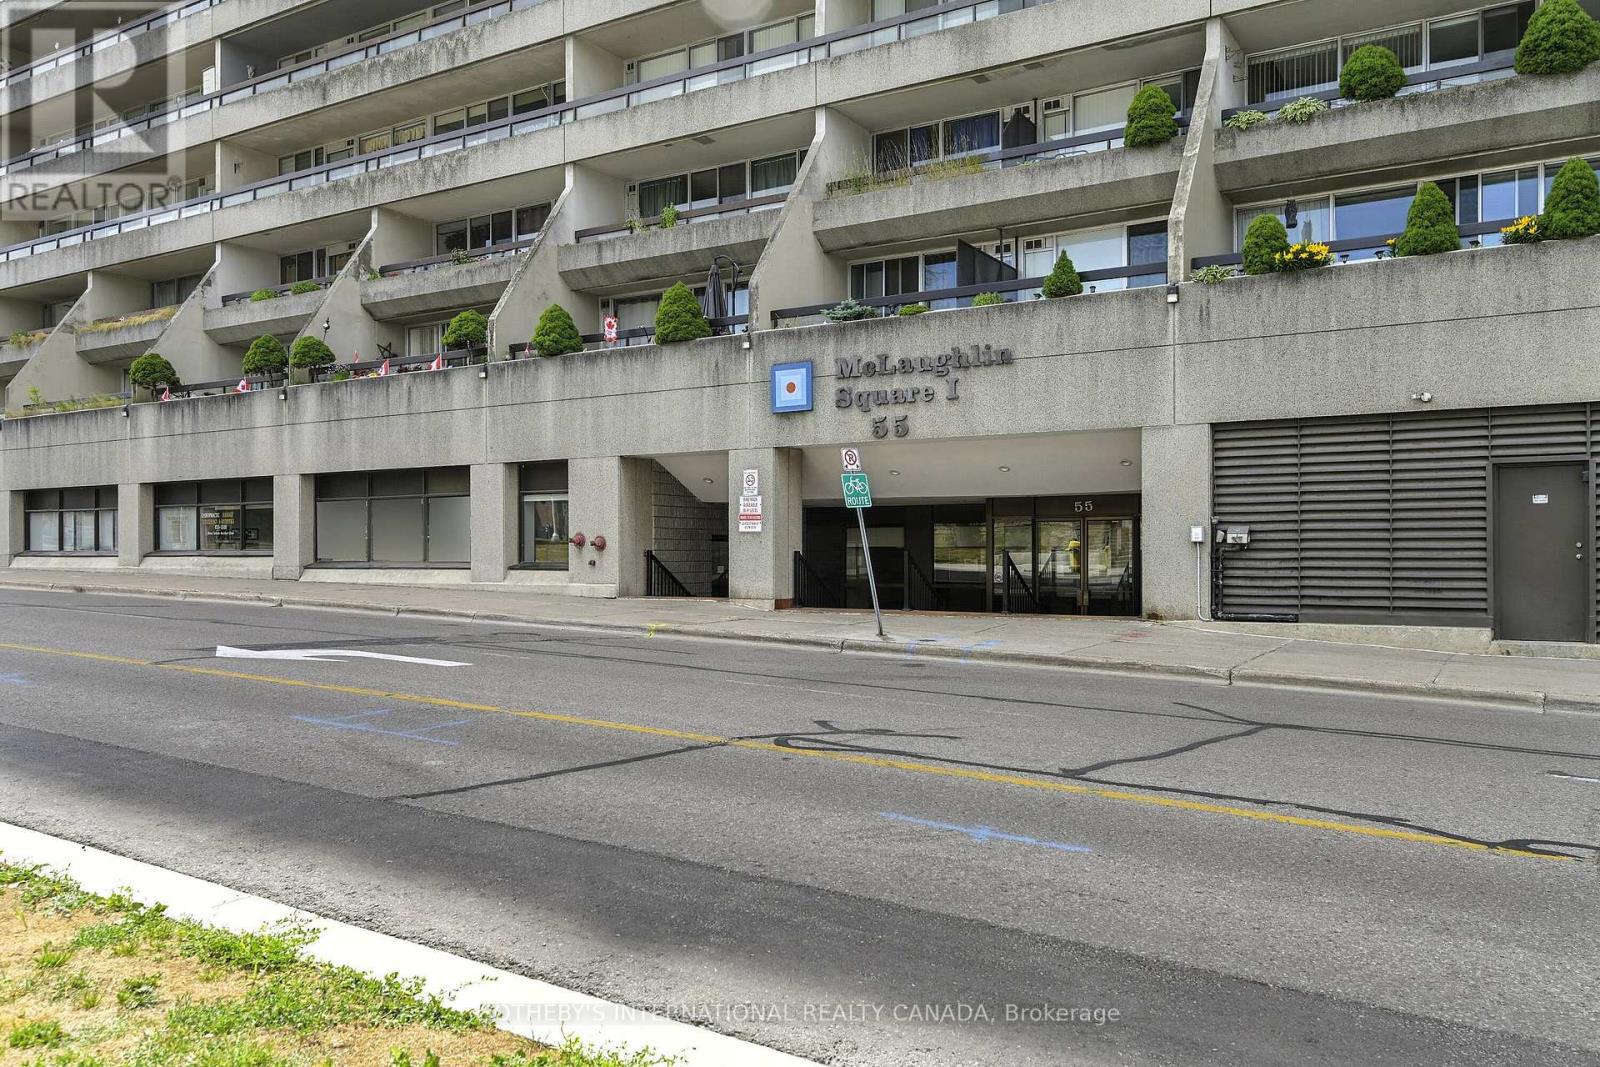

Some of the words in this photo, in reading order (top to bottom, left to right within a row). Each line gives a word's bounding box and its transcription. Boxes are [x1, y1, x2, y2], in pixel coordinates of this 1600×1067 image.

[834, 344, 1013, 379] McLaughlin
[835, 384, 935, 412] Square
[872, 414, 910, 439] 55
[847, 496, 870, 506] ROUTE
[1074, 500, 1094, 513] 55
